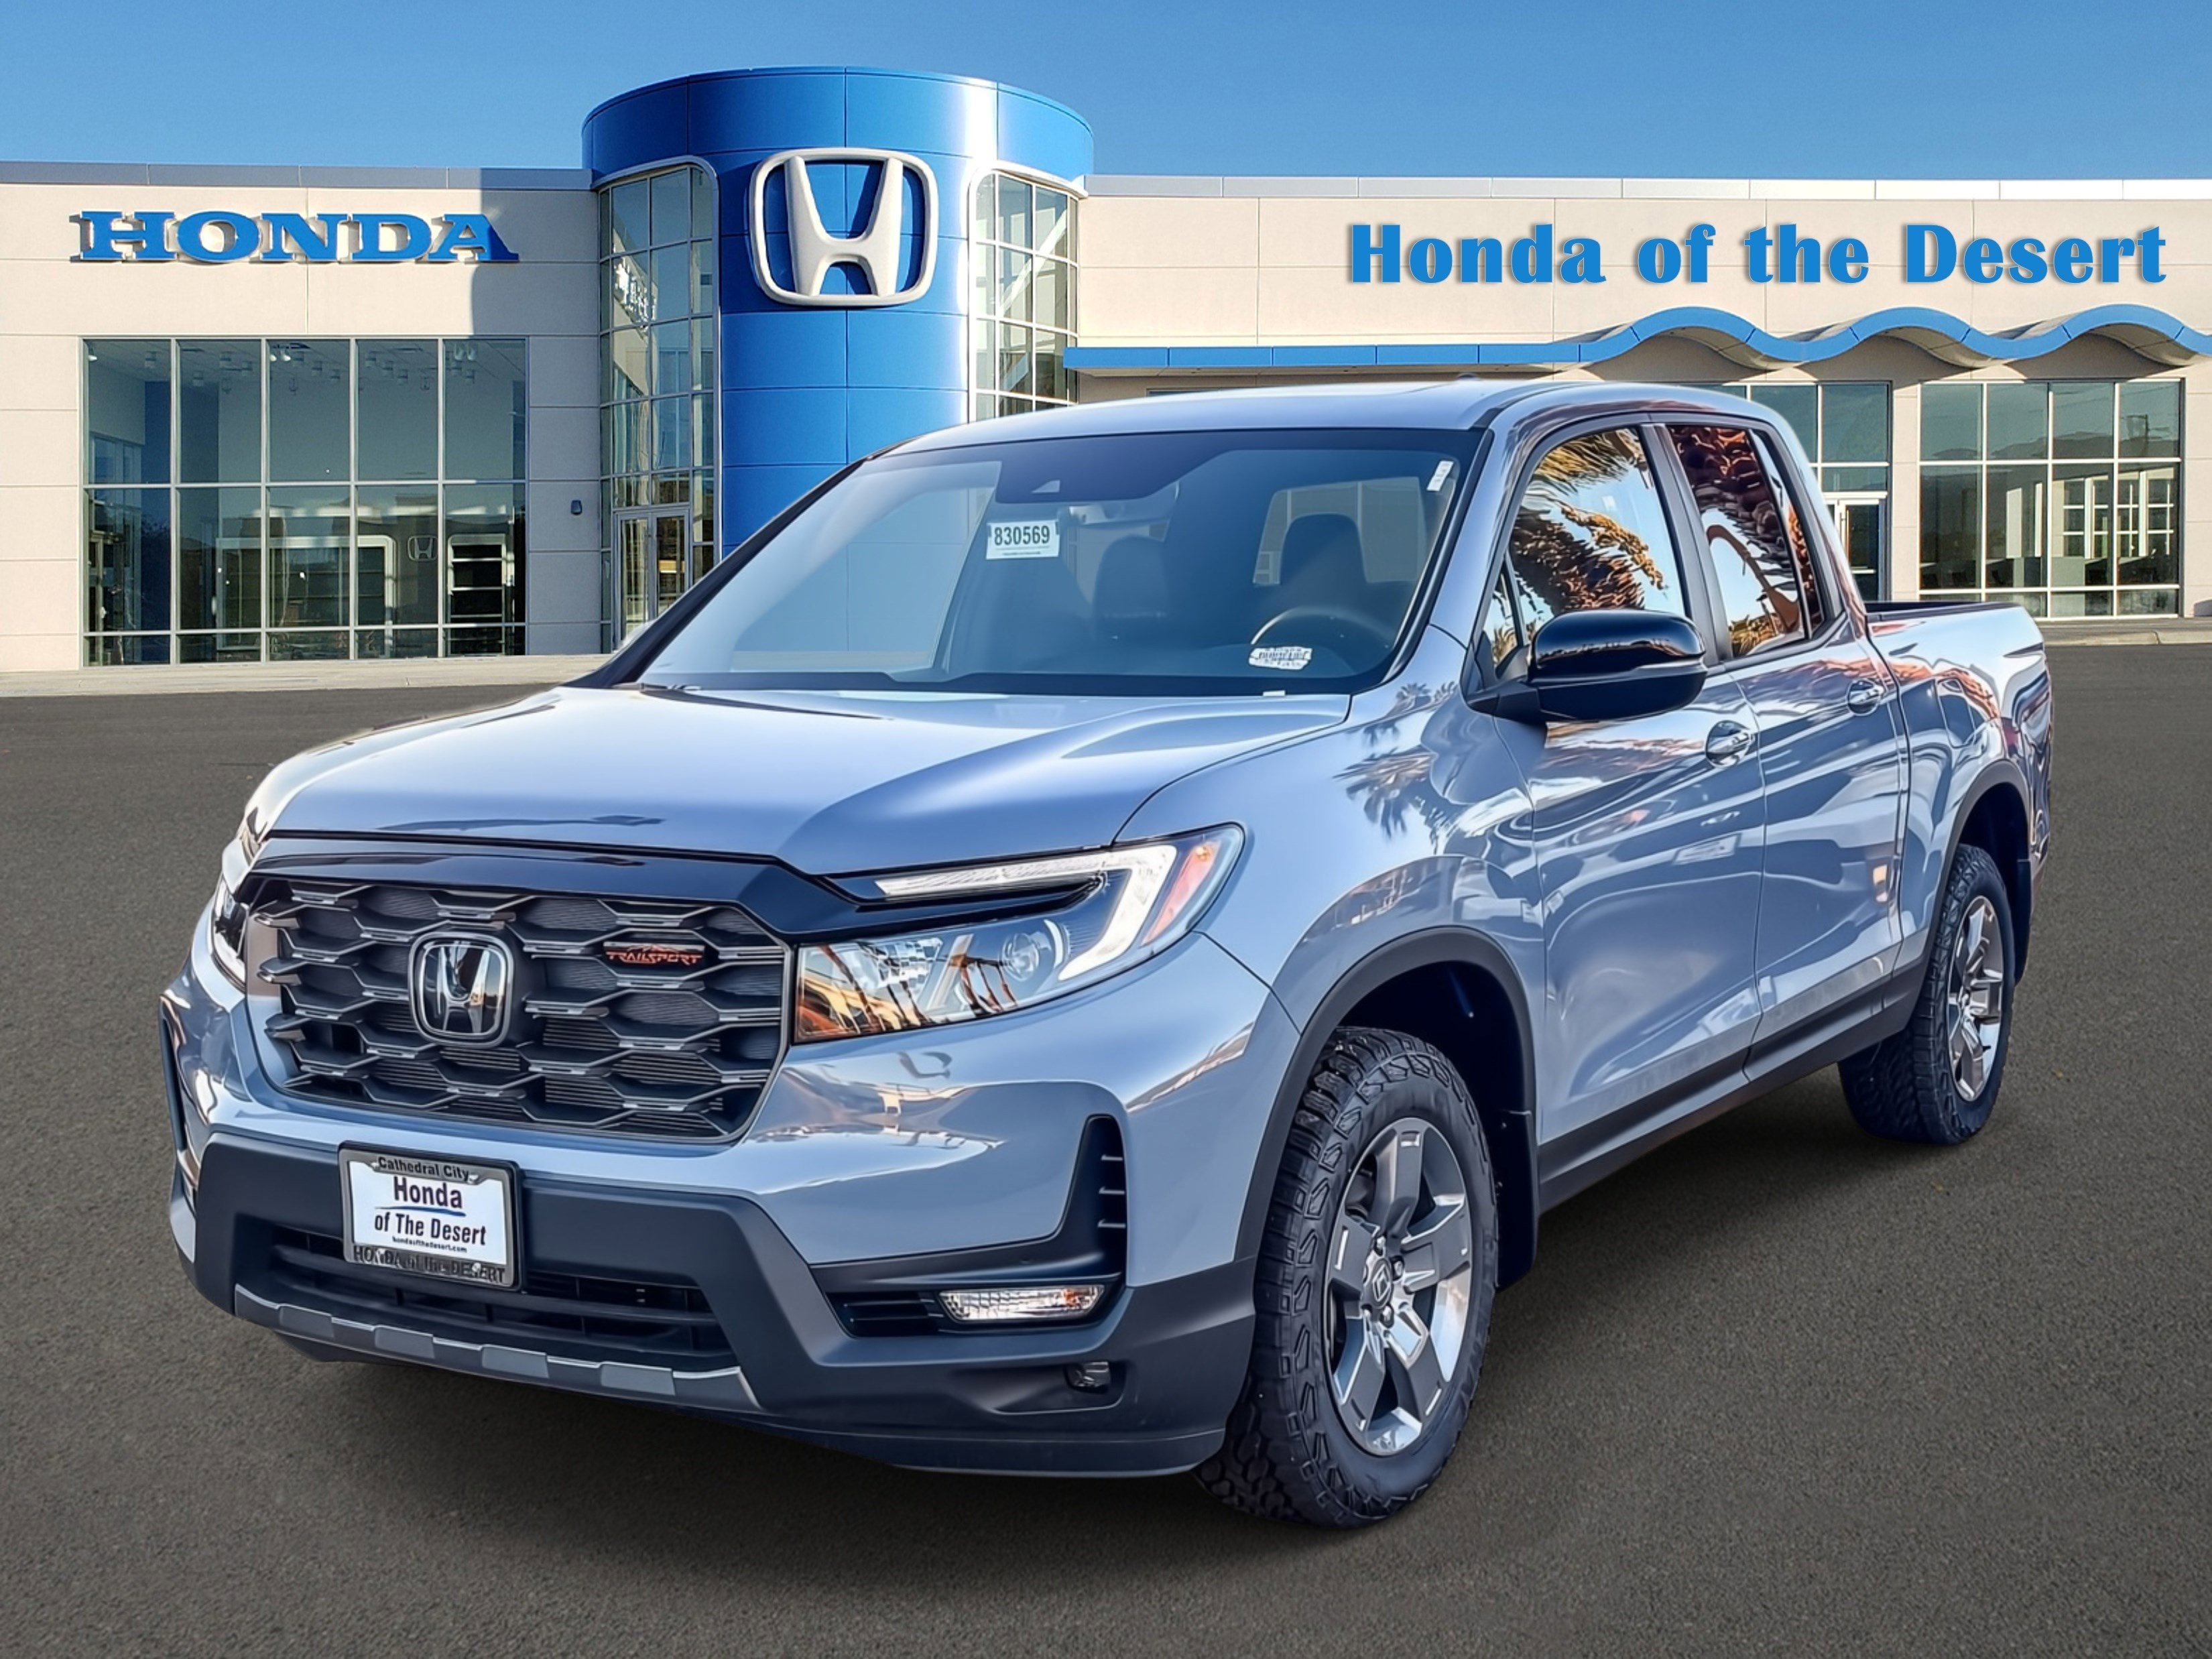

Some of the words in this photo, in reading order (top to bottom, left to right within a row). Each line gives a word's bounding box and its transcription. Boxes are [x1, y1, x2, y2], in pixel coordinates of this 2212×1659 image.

[70, 211, 519, 263] HONDA
[1351, 223, 1607, 284] Honda
[1638, 223, 1717, 284] of
[1743, 223, 1869, 284] the
[1906, 224, 2167, 284] Desert
[994, 525, 1050, 546] 830569
[605, 951, 702, 965] TRAILSPORT
[377, 1156, 440, 1175] Cathedral
[443, 1164, 469, 1182] City
[393, 1176, 463, 1209] Honda
[374, 1211, 391, 1232] of
[395, 1213, 424, 1237] The
[430, 1218, 487, 1245] Desert
